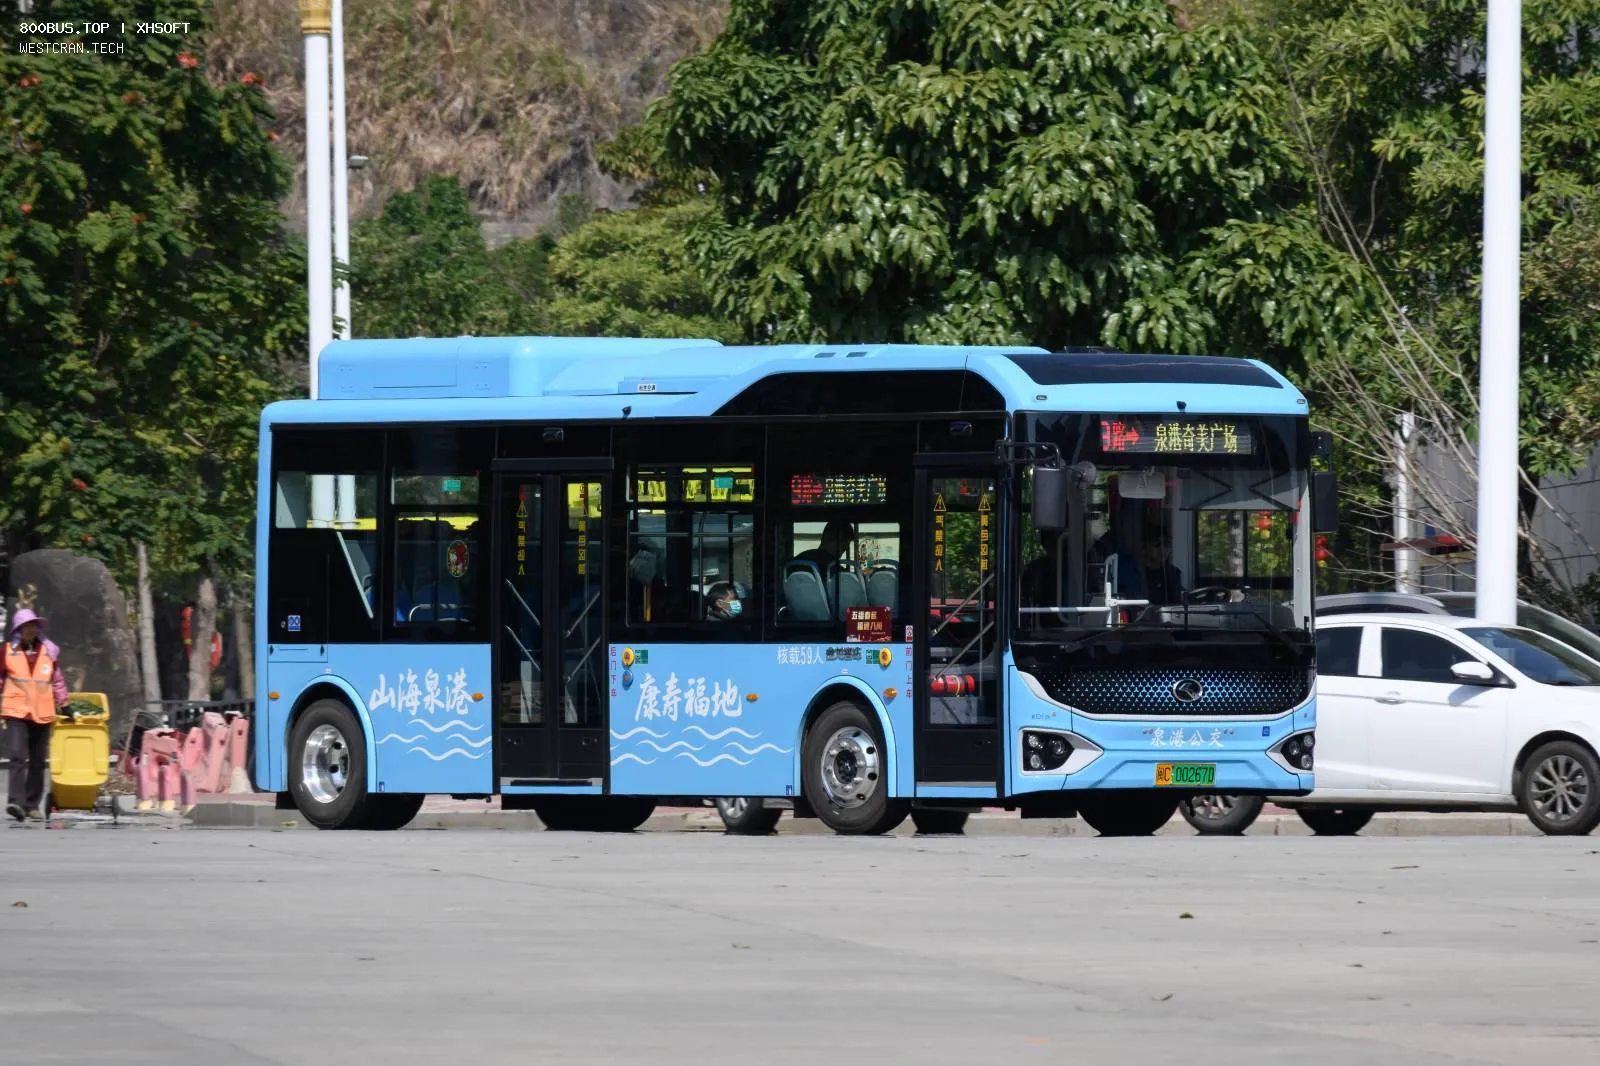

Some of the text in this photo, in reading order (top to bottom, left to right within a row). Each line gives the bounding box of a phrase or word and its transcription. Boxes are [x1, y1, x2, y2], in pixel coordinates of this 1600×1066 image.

[1154, 422, 1238, 453] 泉港奇美广场
[368, 667, 473, 716] 山海泉港
[634, 671, 743, 722] 康寿福地
[1151, 727, 1225, 748] 泉港公交
